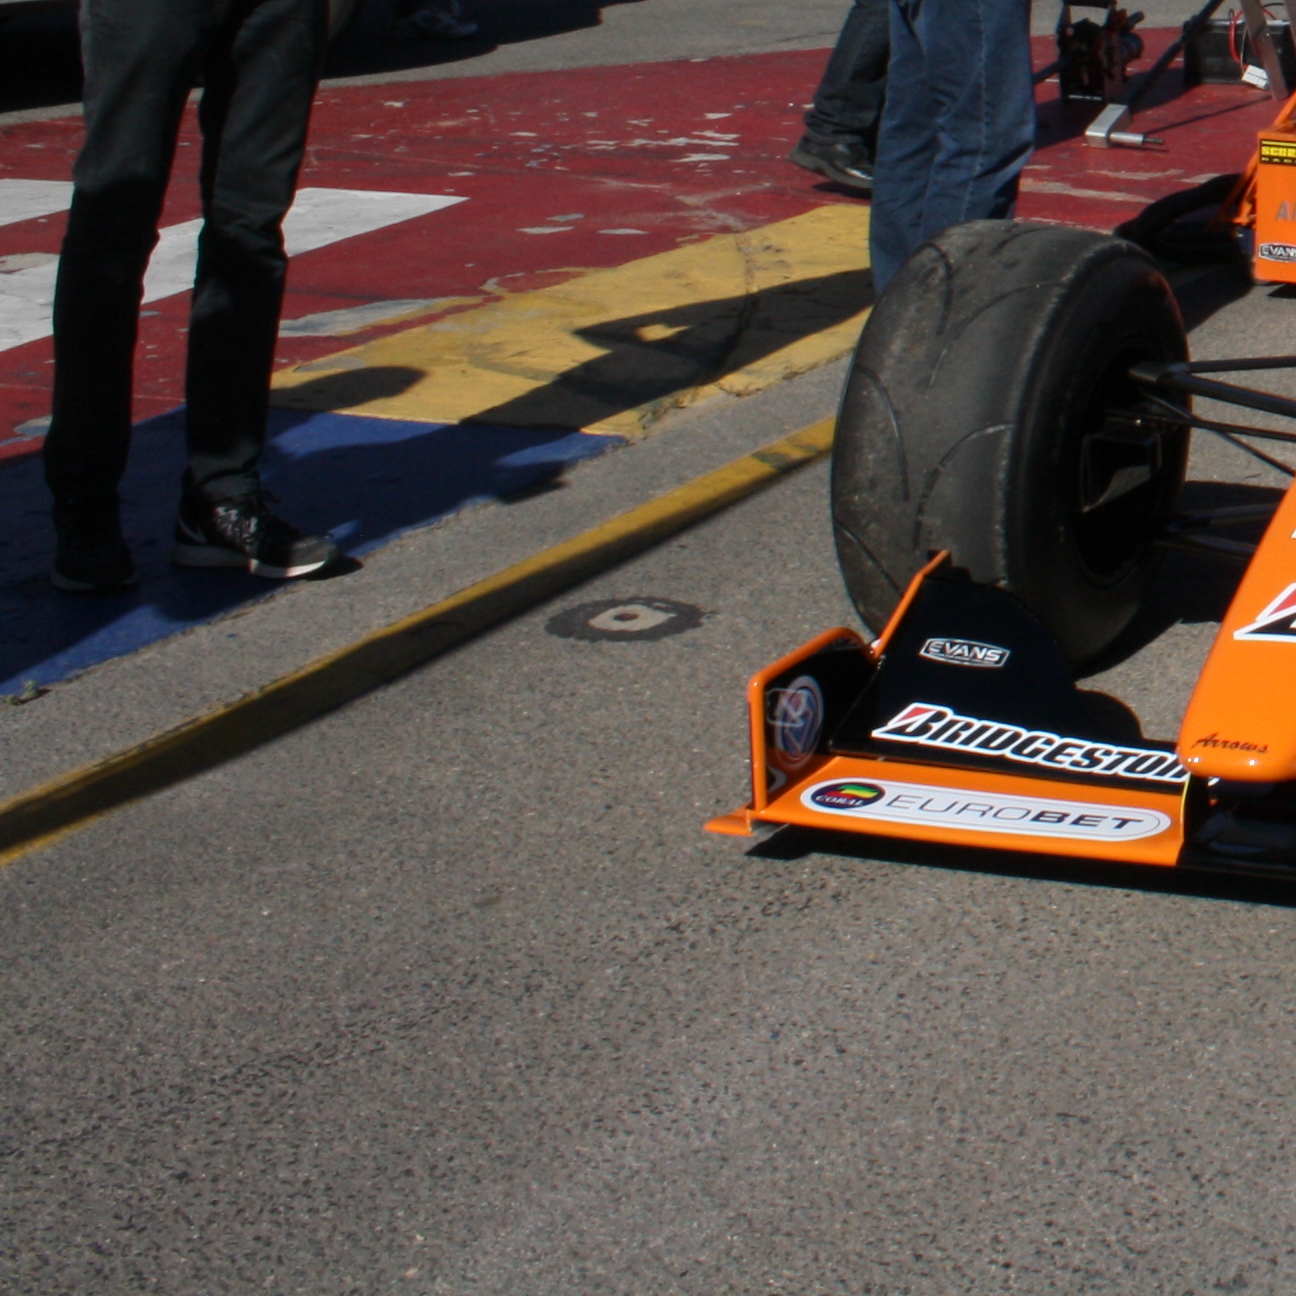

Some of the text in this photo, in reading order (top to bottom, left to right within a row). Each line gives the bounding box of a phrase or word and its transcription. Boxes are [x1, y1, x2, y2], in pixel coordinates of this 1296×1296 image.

[927, 640, 1003, 662] EVANS
[1195, 732, 1269, 755] Arrows
[885, 793, 1144, 831] EUROBET
